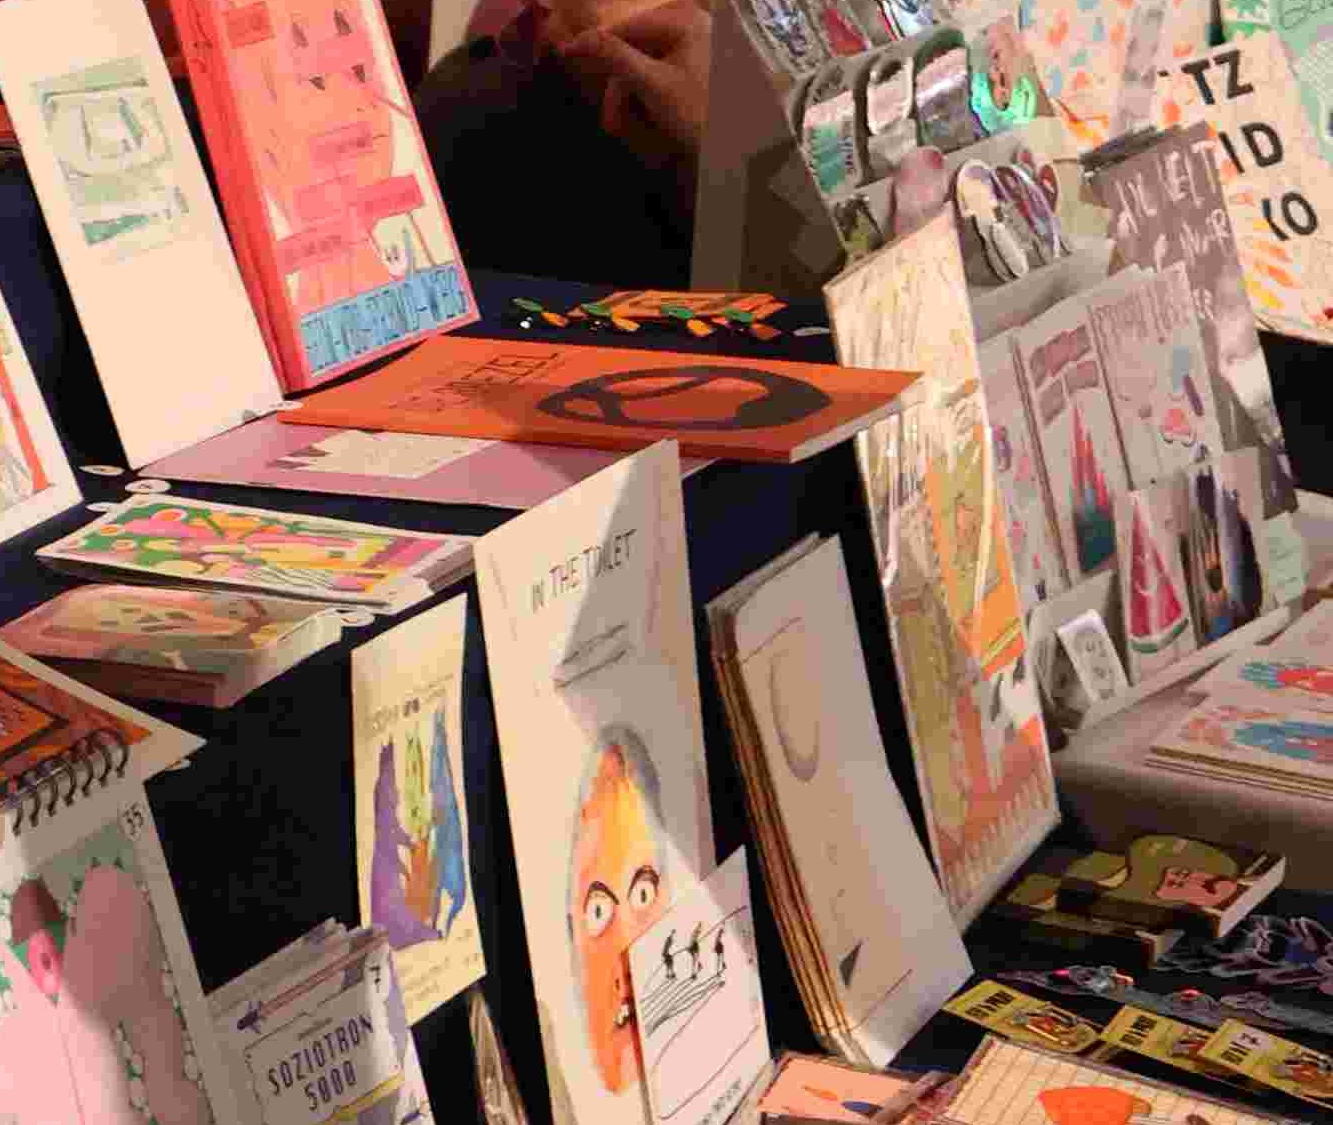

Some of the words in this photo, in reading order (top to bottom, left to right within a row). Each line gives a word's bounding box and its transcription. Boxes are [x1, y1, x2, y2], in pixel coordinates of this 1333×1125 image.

[1158, 49, 1254, 104] TZ
[549, 555, 580, 599] THE
[268, 1013, 373, 1096] SOZIOTRON
[303, 1060, 357, 1111] 5000
